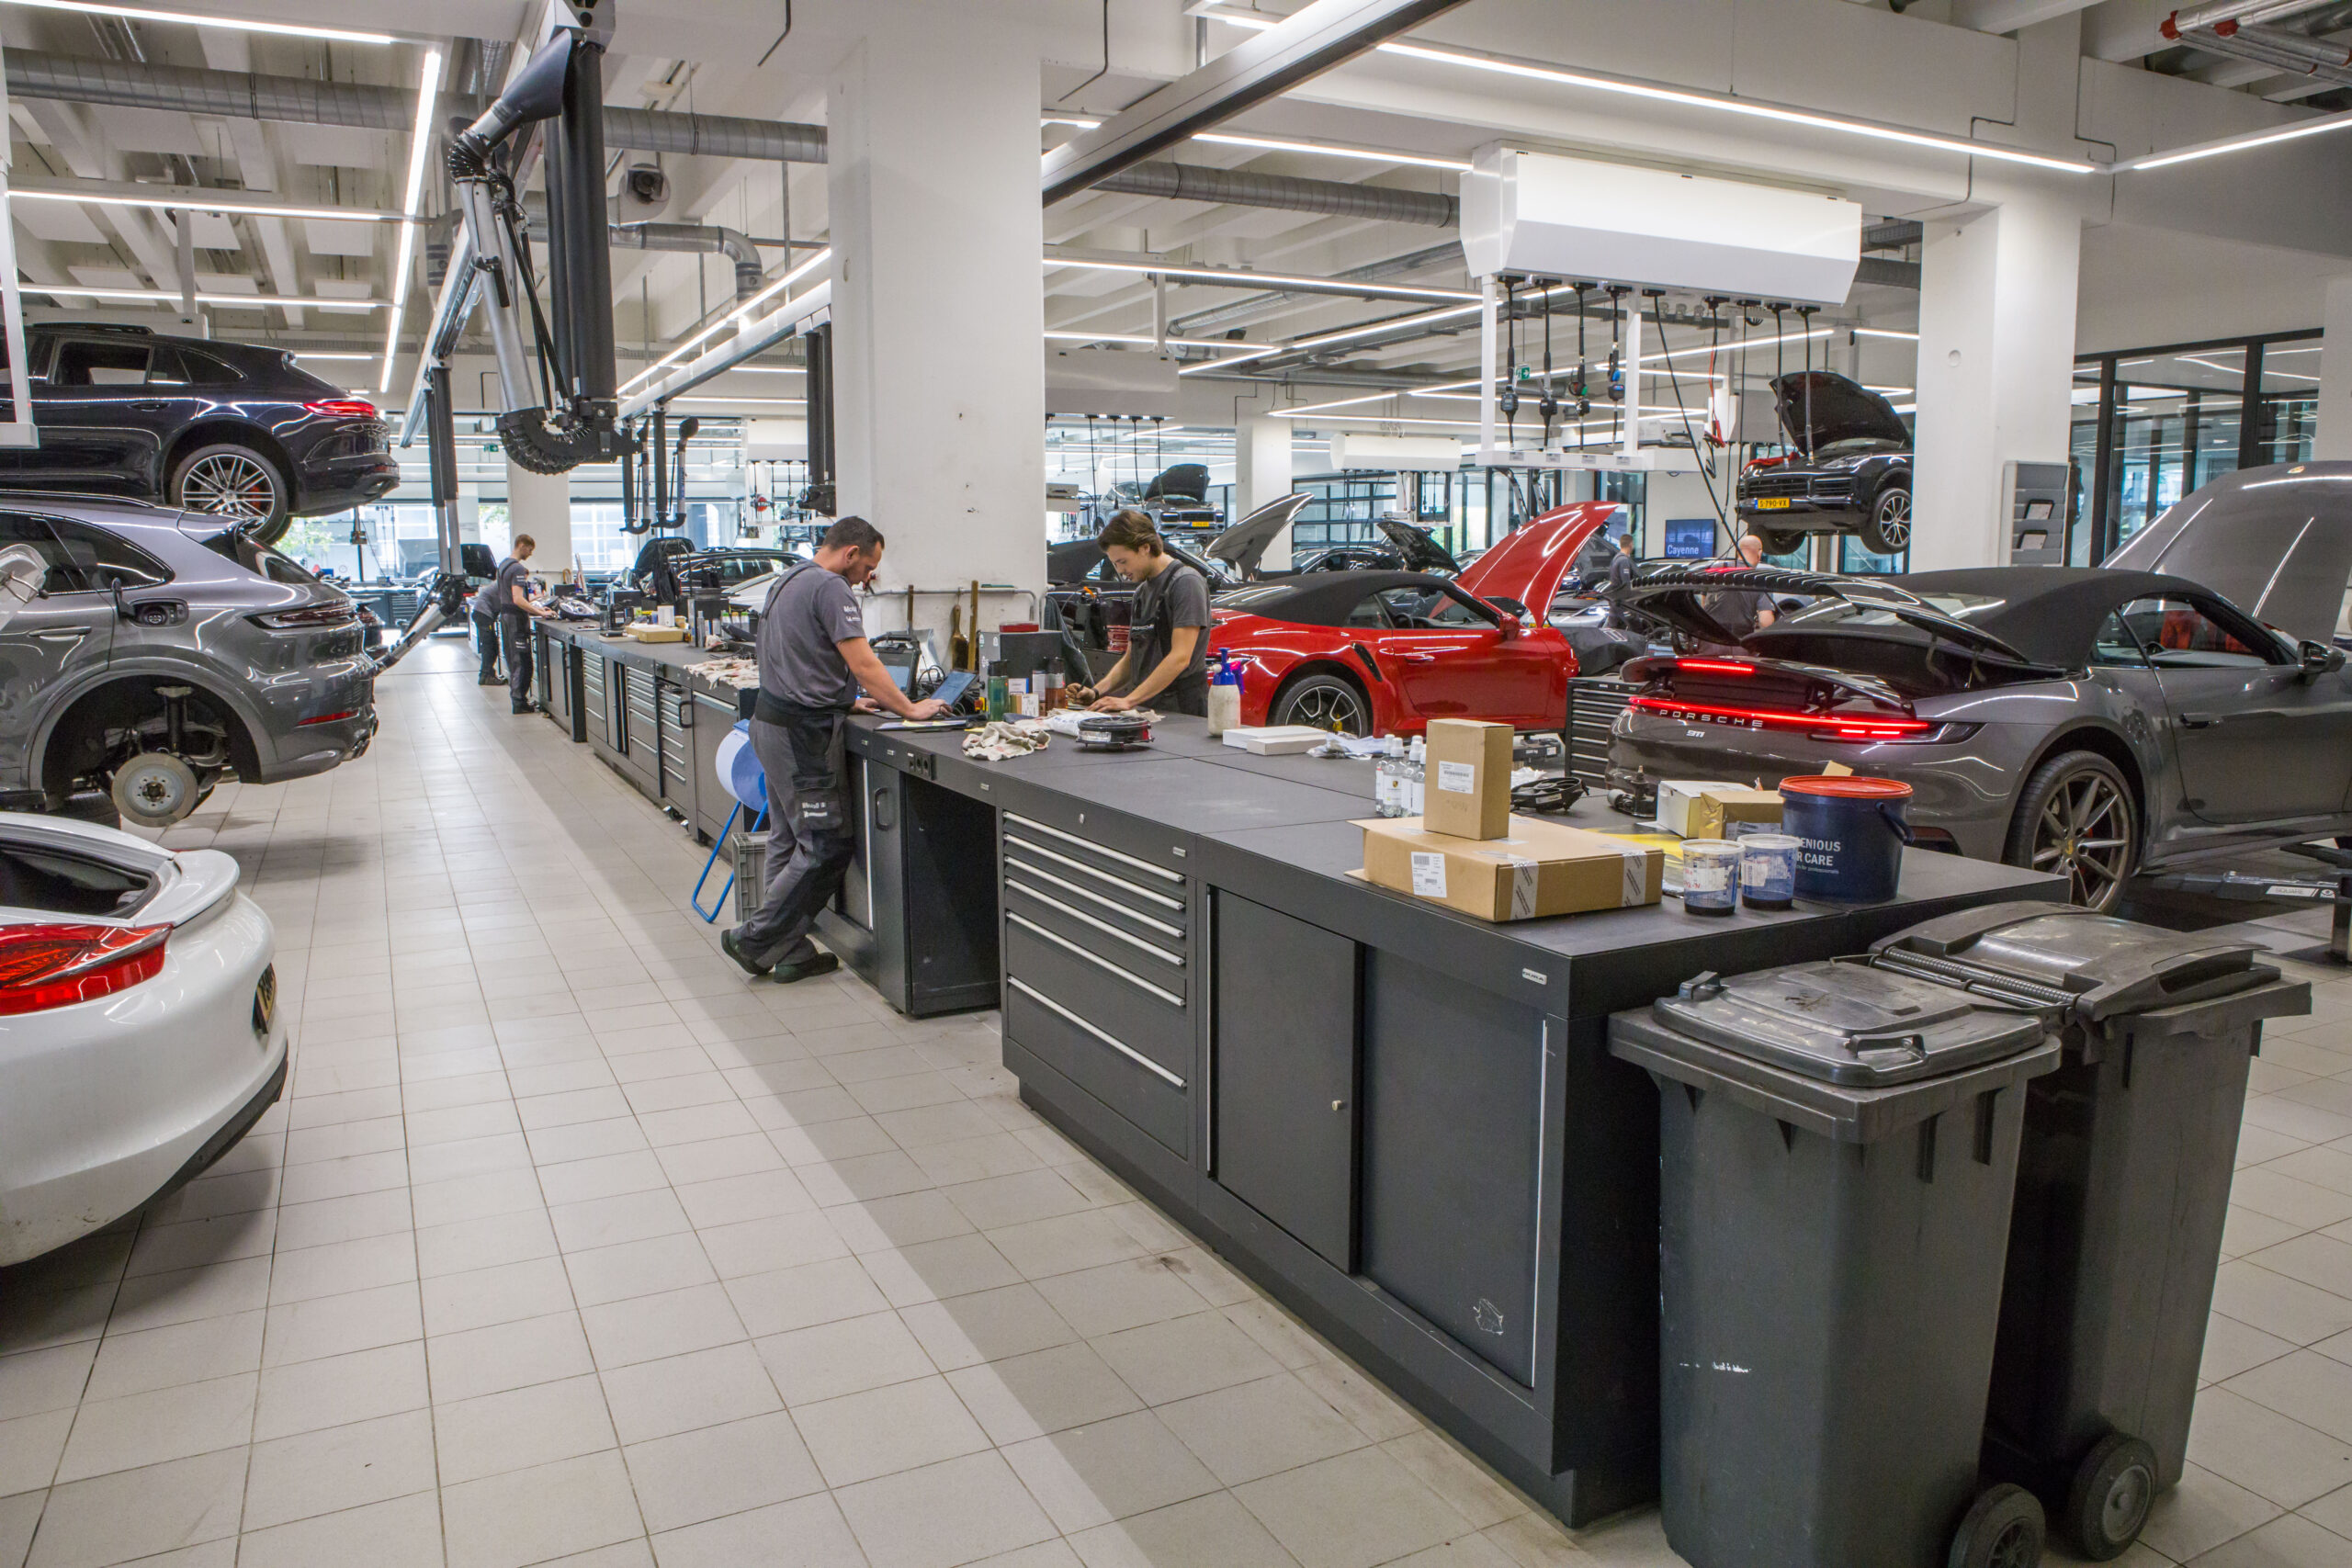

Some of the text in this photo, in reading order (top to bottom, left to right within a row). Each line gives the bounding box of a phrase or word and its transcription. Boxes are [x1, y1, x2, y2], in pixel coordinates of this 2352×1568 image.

[1758, 499, 1788, 508] S-790-VX
[1668, 545, 1699, 556] Cayenne
[1659, 709, 1764, 728] PORSCHE
[1686, 729, 1705, 738] 911
[1800, 837, 1841, 852] ENIOUS
[1804, 852, 1835, 866] CARE
